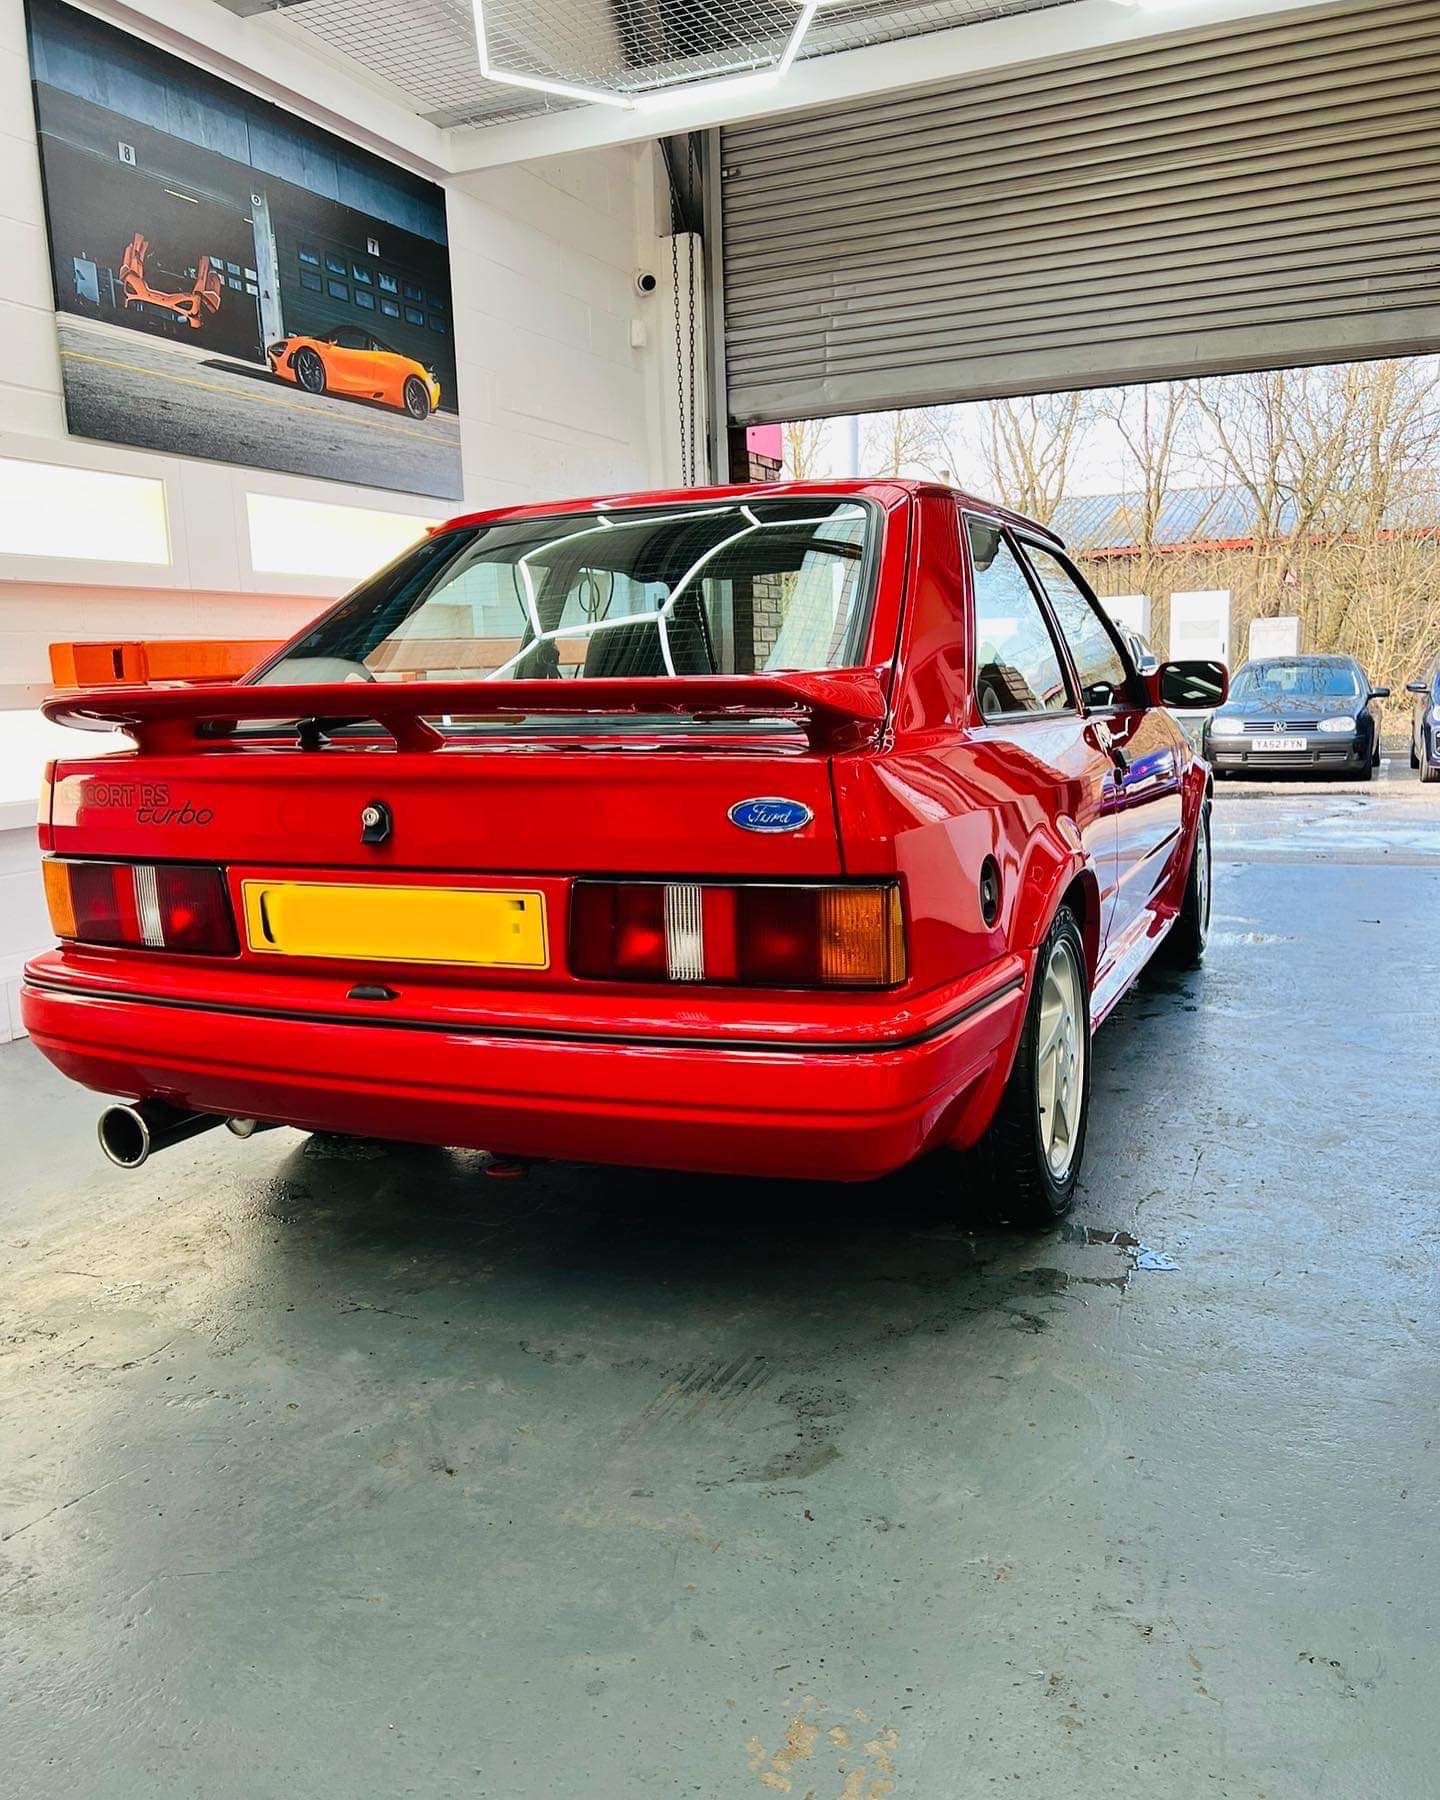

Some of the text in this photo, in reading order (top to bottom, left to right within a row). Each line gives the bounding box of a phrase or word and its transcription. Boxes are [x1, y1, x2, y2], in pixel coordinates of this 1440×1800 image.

[124, 146, 131, 161] 8
[370, 239, 376, 253] 7
[139, 783, 170, 807] RS
[135, 800, 214, 825] turbo
[747, 804, 793, 824] Ford
